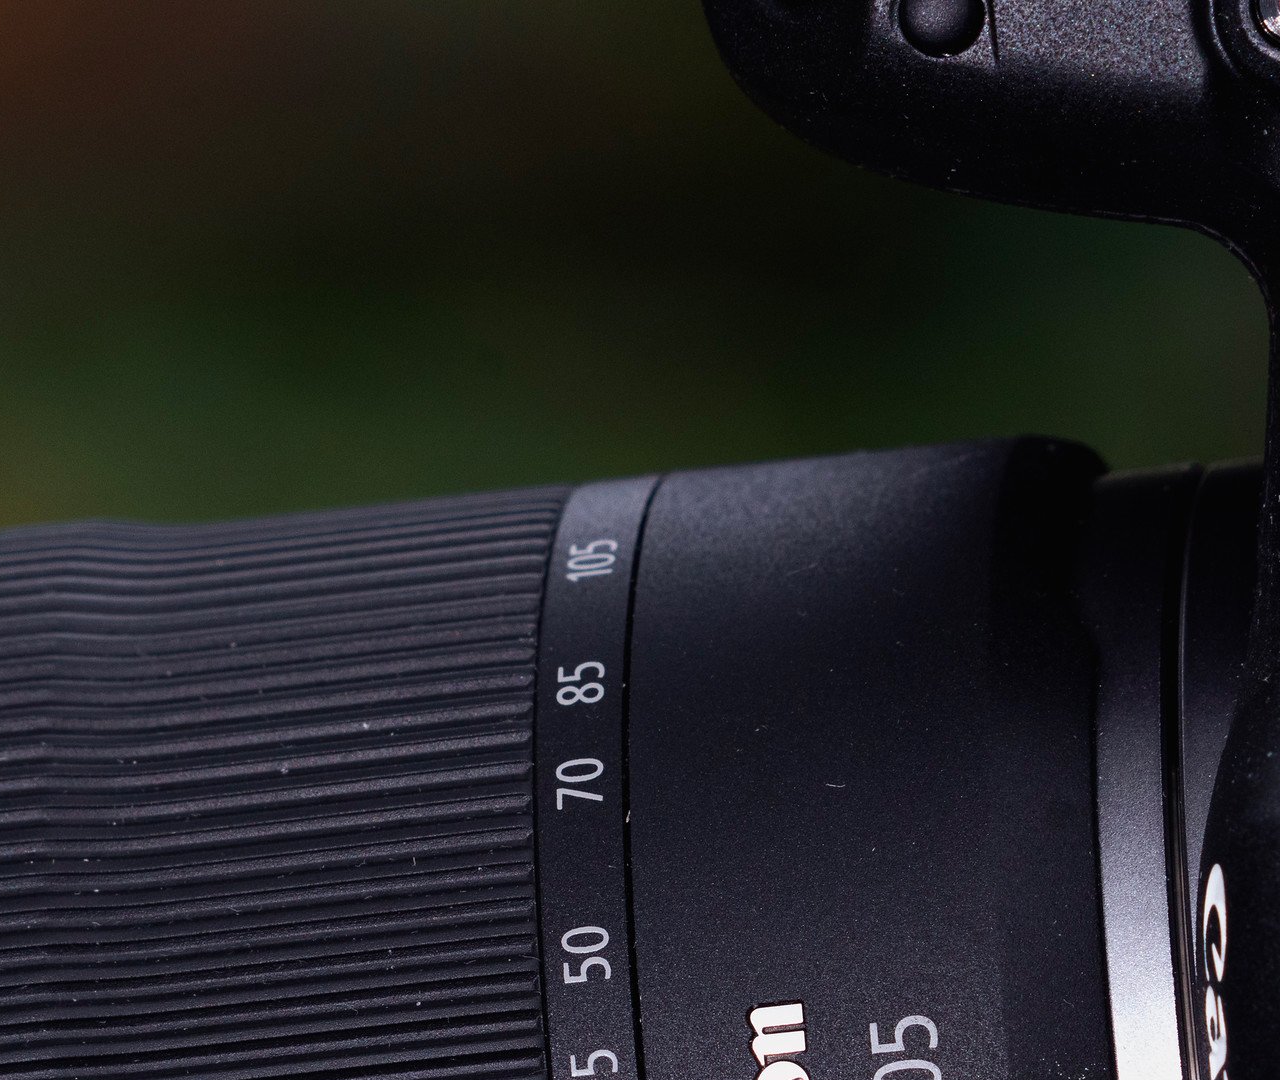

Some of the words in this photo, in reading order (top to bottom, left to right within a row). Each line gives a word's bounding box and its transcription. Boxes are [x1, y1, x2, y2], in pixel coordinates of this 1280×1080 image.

[566, 539, 619, 583] 105
[556, 661, 605, 706] 85
[555, 757, 604, 811] 70
[560, 925, 612, 984] 50
